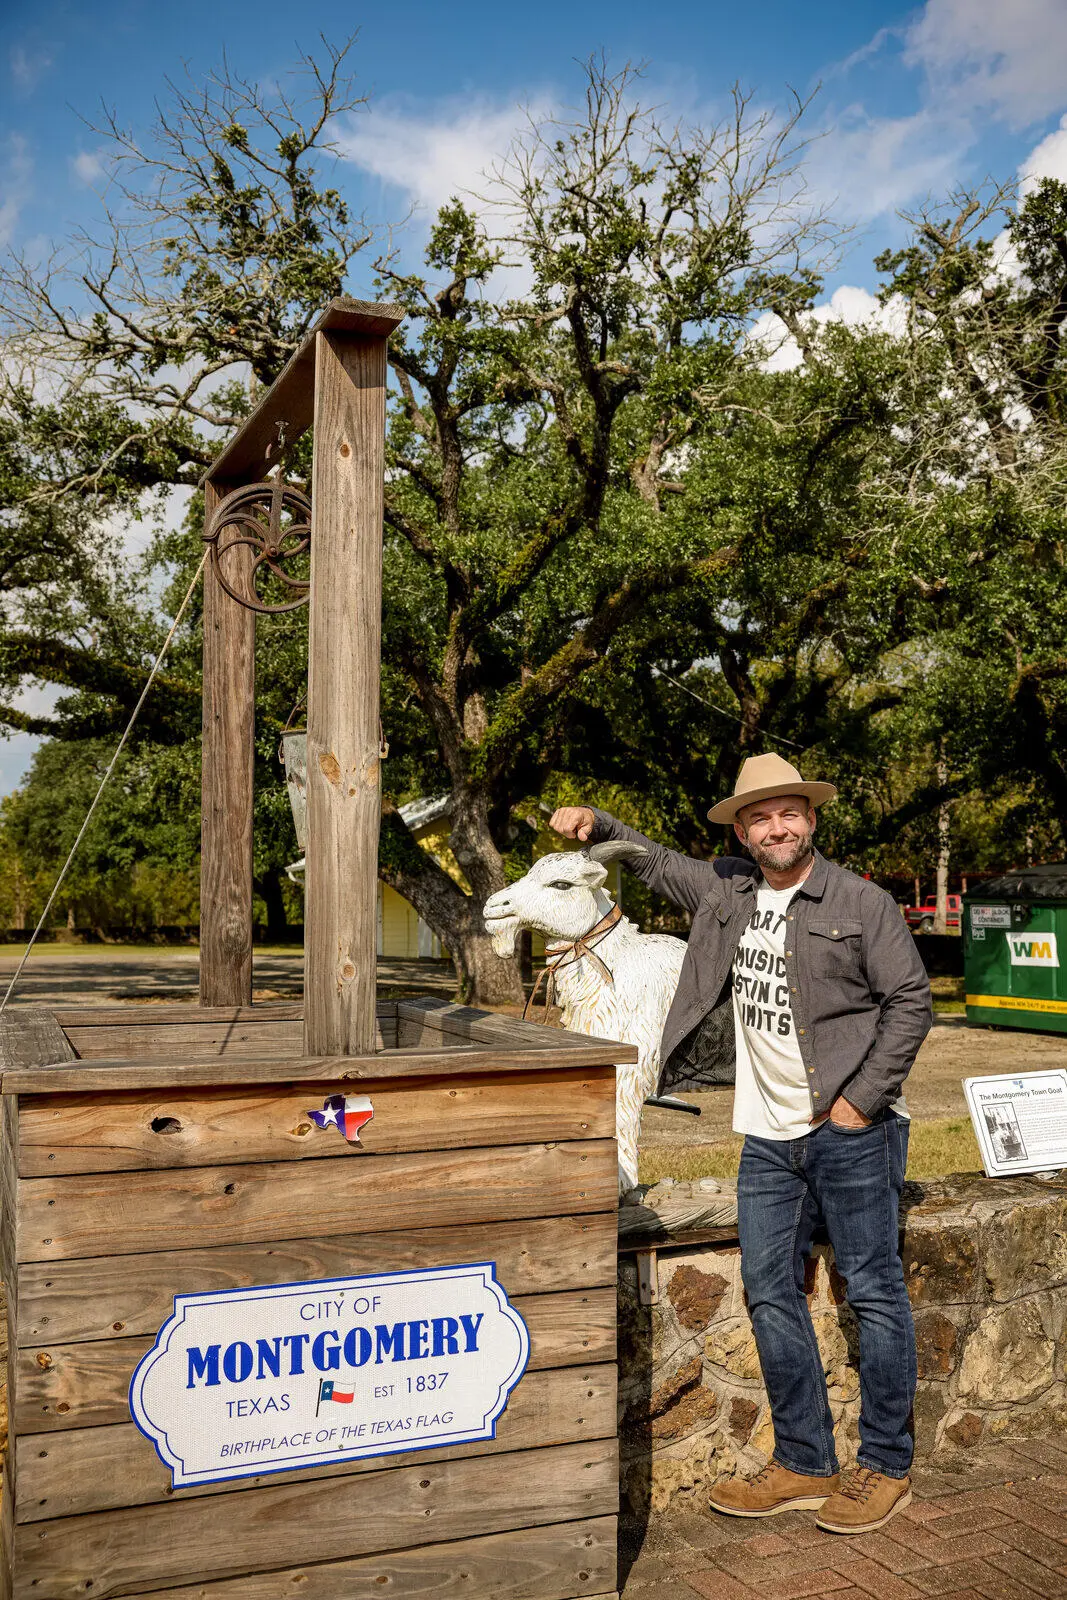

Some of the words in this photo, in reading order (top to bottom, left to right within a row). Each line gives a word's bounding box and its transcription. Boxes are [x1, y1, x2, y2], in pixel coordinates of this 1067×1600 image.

[736, 946, 786, 978] MUSIC
[1013, 942, 1052, 958] WM
[733, 972, 770, 1003] STIN
[742, 1003, 791, 1036] IMITS
[992, 1091, 1030, 1099] Montgomery
[300, 1300, 345, 1321] CITY
[353, 1296, 381, 1315] OF
[186, 1312, 484, 1389] MONTGOMERY
[226, 1393, 291, 1418] TEXAS
[374, 1385, 395, 1398] EST
[407, 1372, 449, 1393] 1837
[220, 1432, 312, 1457] BIRTHPLACE
[315, 1428, 337, 1442] OF
[341, 1424, 367, 1438] THE
[371, 1417, 412, 1434] TEXAS
[416, 1411, 454, 1428] FLAG
